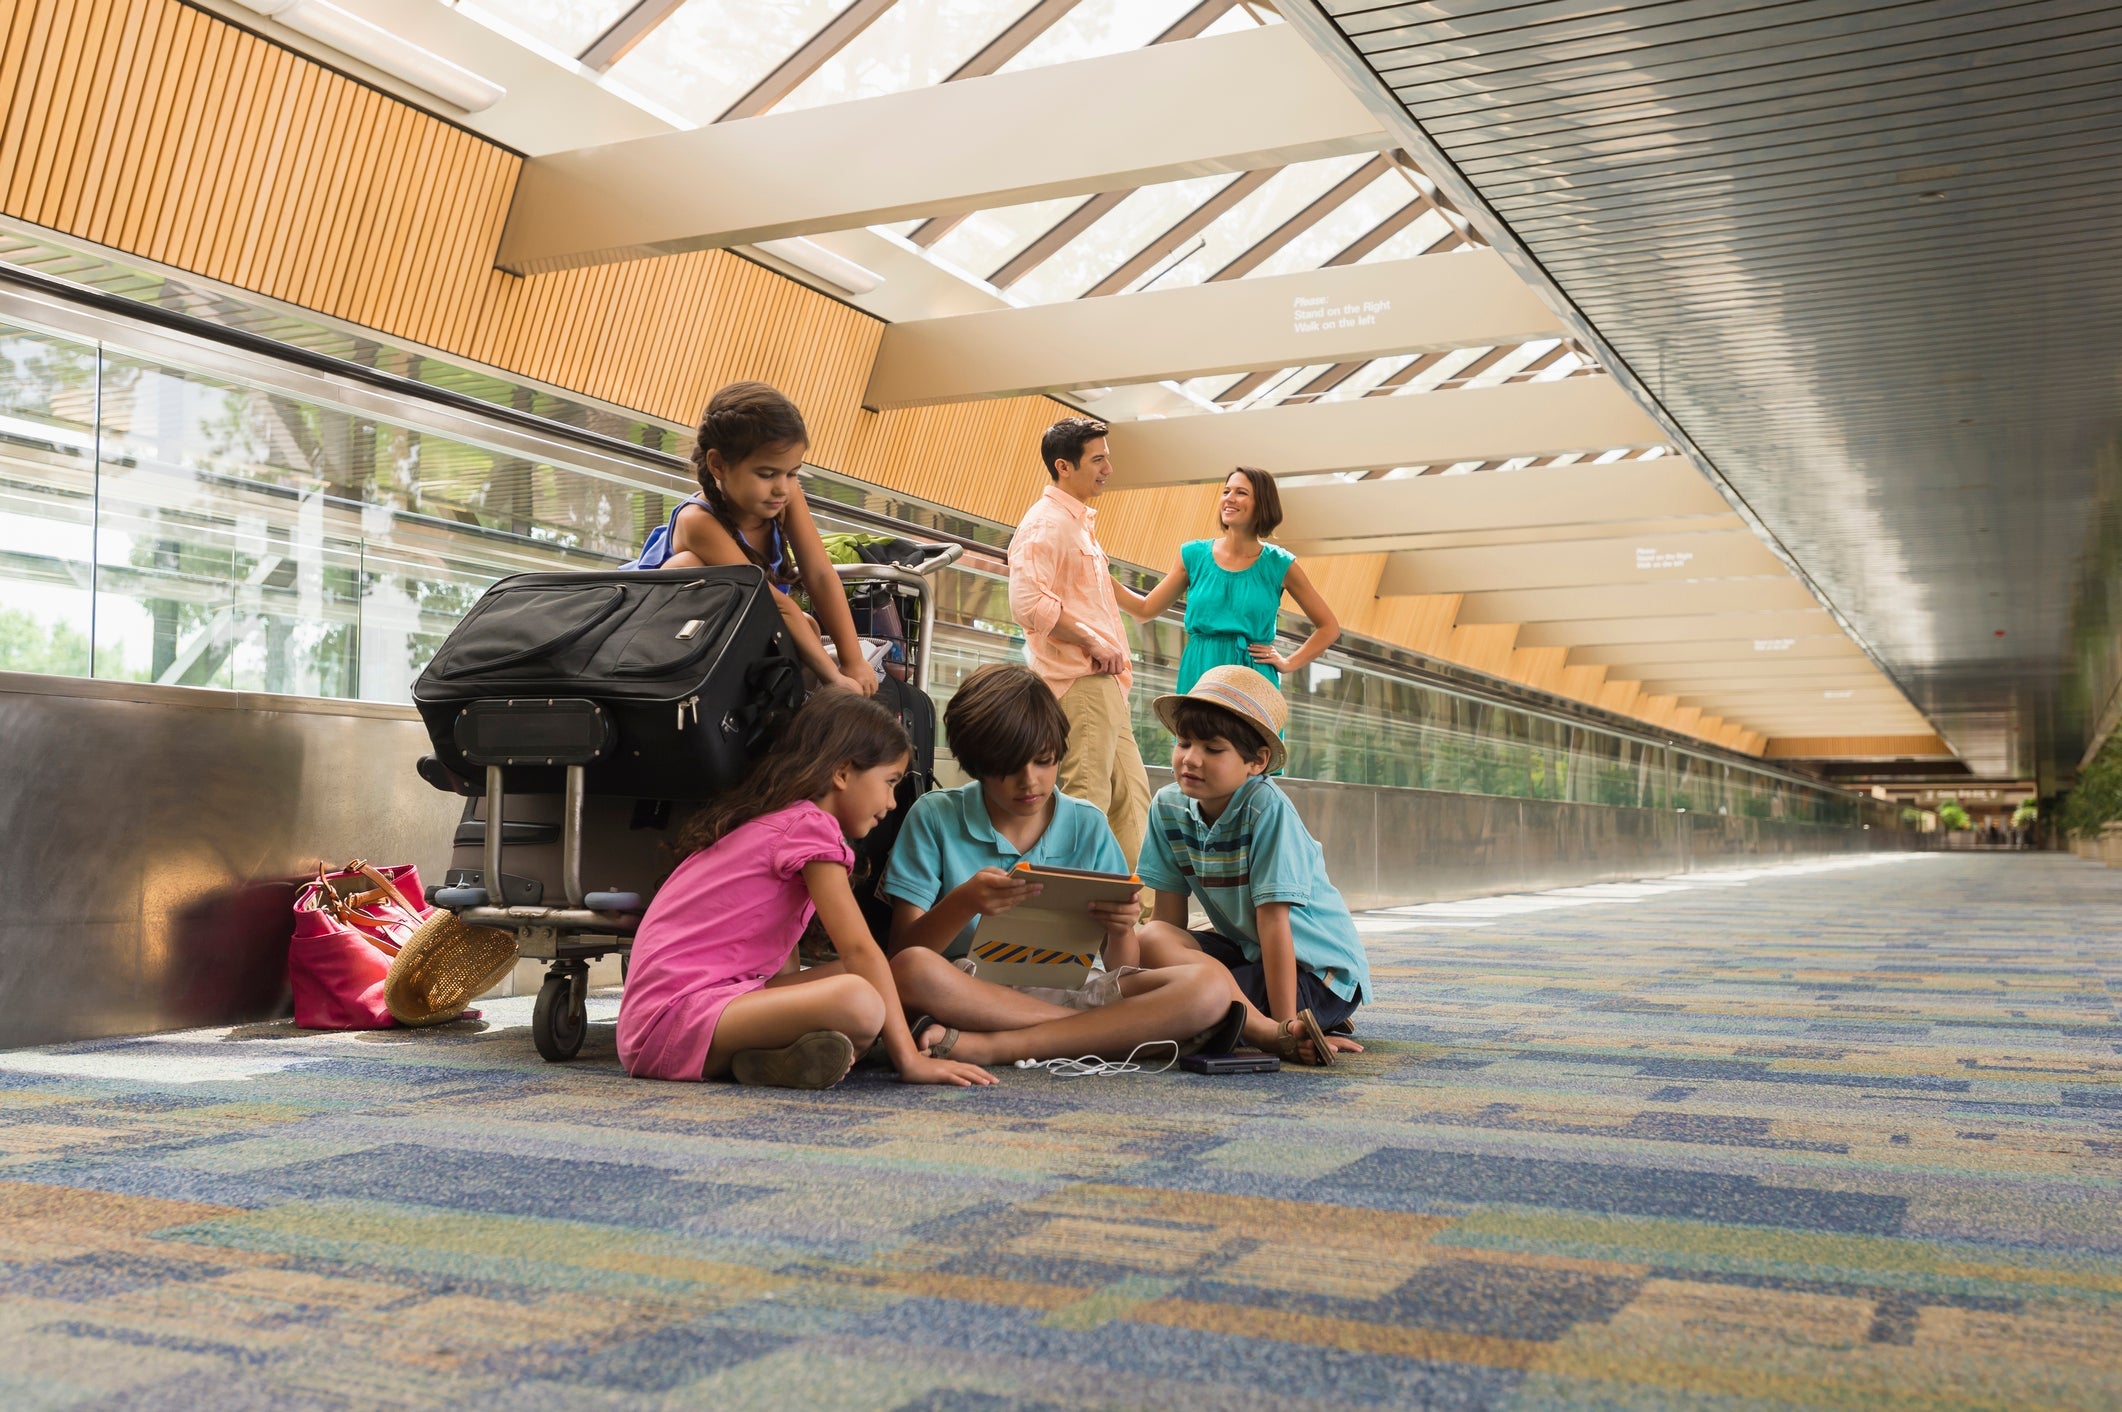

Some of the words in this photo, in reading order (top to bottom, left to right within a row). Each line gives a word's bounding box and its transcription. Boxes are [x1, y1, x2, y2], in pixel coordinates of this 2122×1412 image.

[1294, 308, 1324, 320] Stand
[1327, 308, 1340, 317] on
[1343, 303, 1360, 314] the
[1363, 300, 1391, 313] Right
[1294, 321, 1319, 333] Walk
[1322, 321, 1336, 330] on
[1339, 318, 1355, 328] the
[1359, 314, 1376, 326] left
